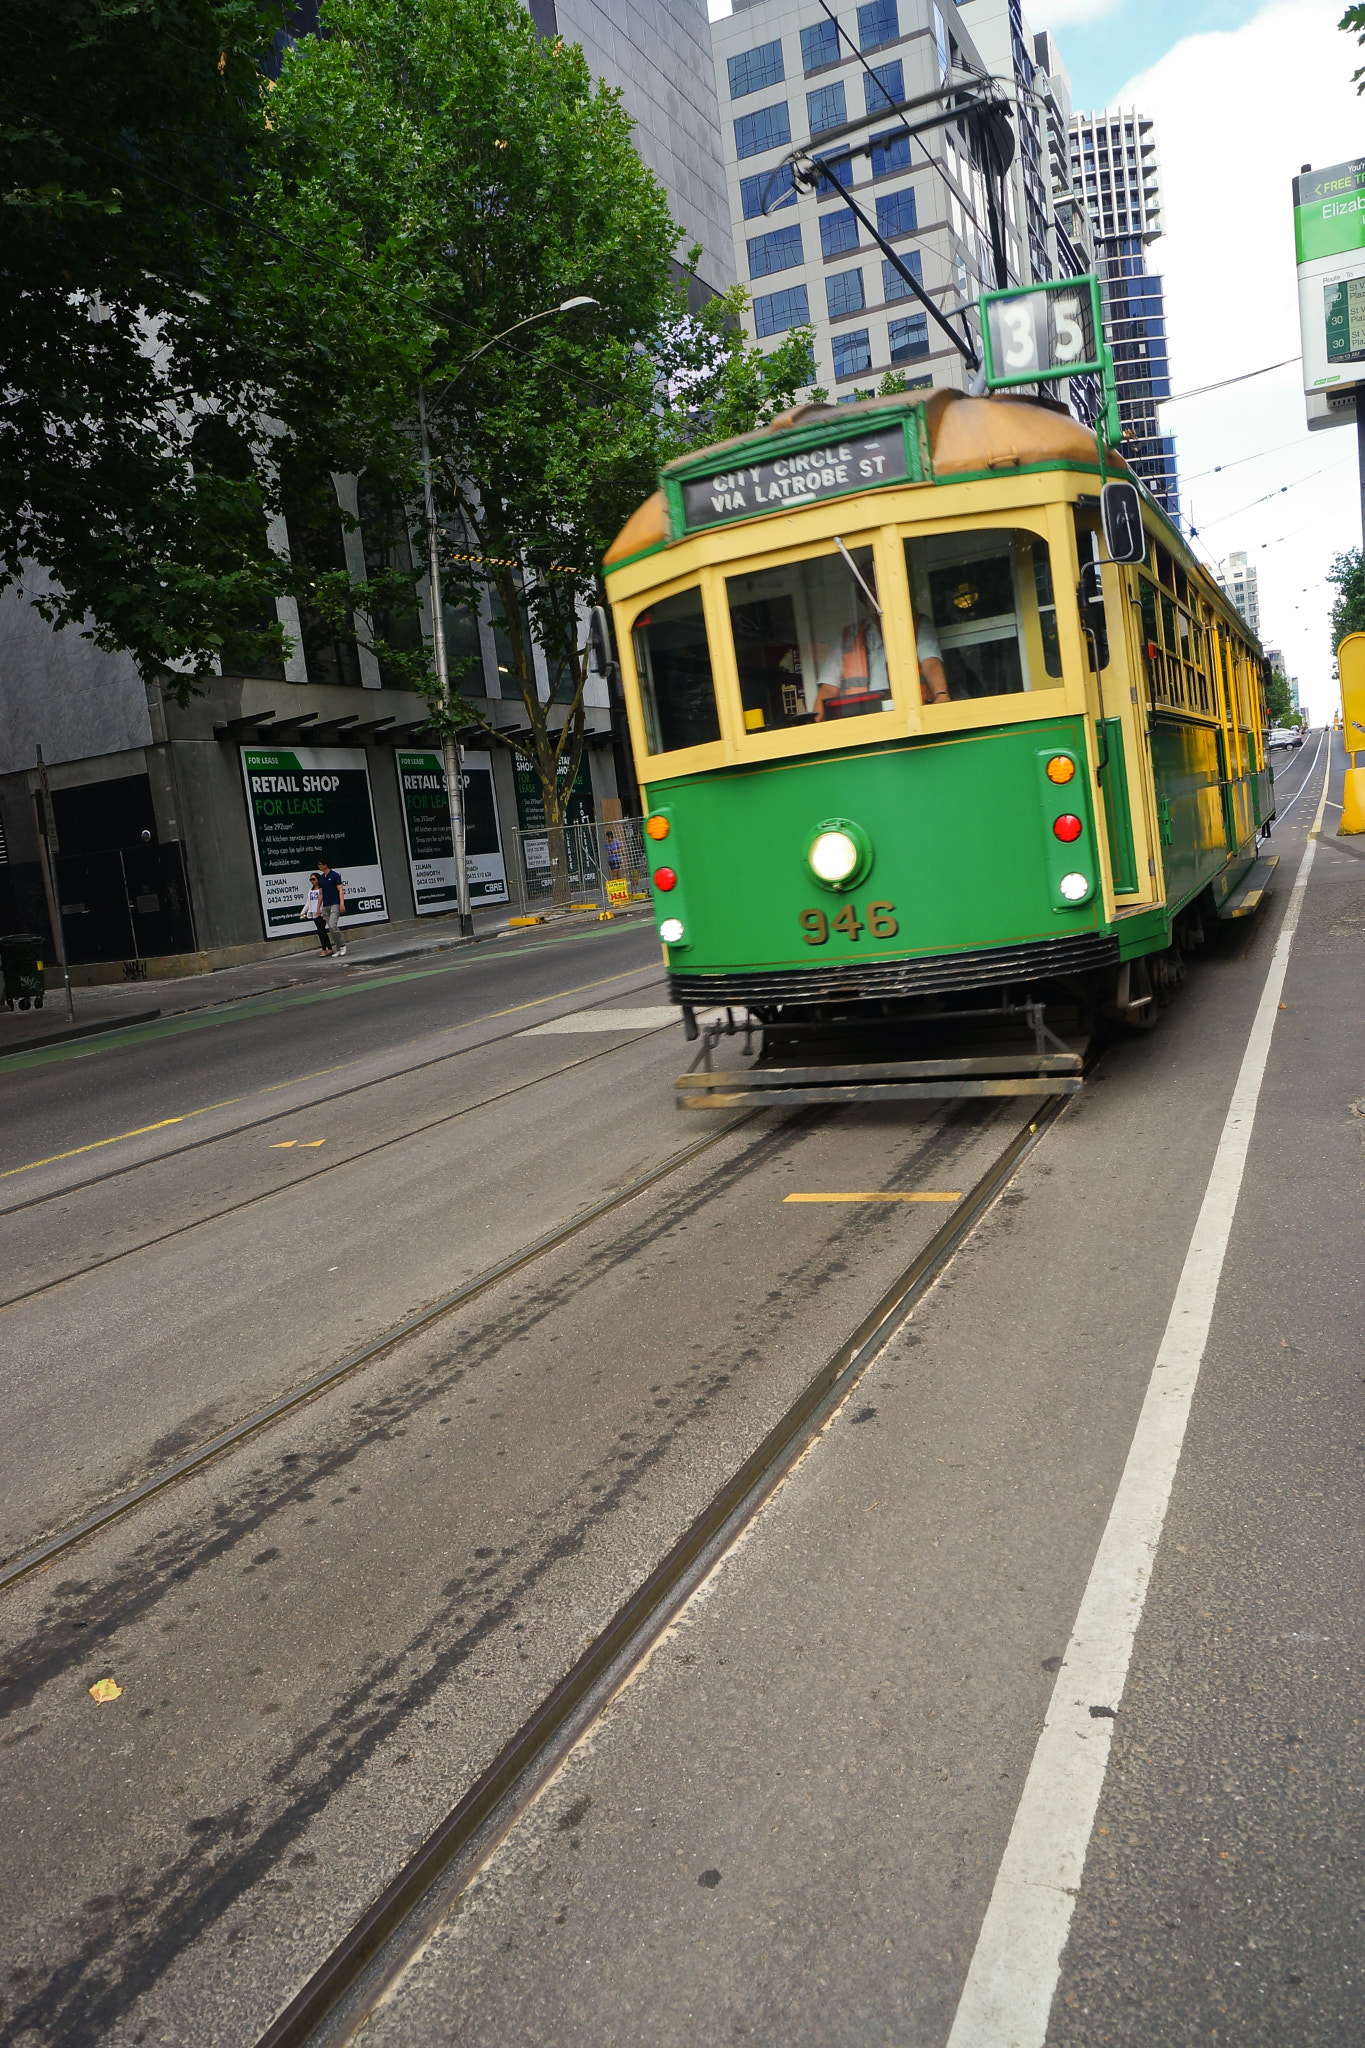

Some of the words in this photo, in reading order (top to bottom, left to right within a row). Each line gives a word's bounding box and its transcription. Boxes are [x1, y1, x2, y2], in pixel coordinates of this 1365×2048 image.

[1324, 176, 1352, 193] FREE
[1322, 196, 1365, 219] Elizab
[1323, 275, 1341, 284] Route
[1350, 284, 1358, 292] St
[1351, 307, 1359, 315] St
[1332, 315, 1343, 326] 30
[1352, 331, 1360, 339] St
[1332, 338, 1345, 349] 30
[712, 466, 761, 492] CITY
[773, 444, 853, 477] CIRCLE
[711, 491, 746, 513] VIA
[755, 465, 849, 503] LATROBE
[859, 455, 887, 477] ST
[251, 776, 300, 793] RETAIL
[302, 775, 340, 792] SHOP
[403, 775, 441, 790] RETAIL
[517, 774, 529, 783] FOR
[519, 784, 536, 793] LEASE
[255, 799, 285, 816] FOR
[287, 798, 325, 814] LEASE
[406, 795, 429, 809] FOR
[431, 794, 448, 808] LEA
[306, 832, 326, 841] provided
[267, 847, 279, 855] Shop
[268, 858, 290, 867] Available
[265, 879, 287, 887] ZELMAN
[484, 882, 503, 892] CBRE
[266, 886, 299, 895] AINSWORTH
[268, 896, 281, 904] 0424
[283, 894, 293, 902] 225
[294, 893, 304, 901] 999
[358, 899, 382, 911] CBRE
[798, 900, 899, 946] 946
